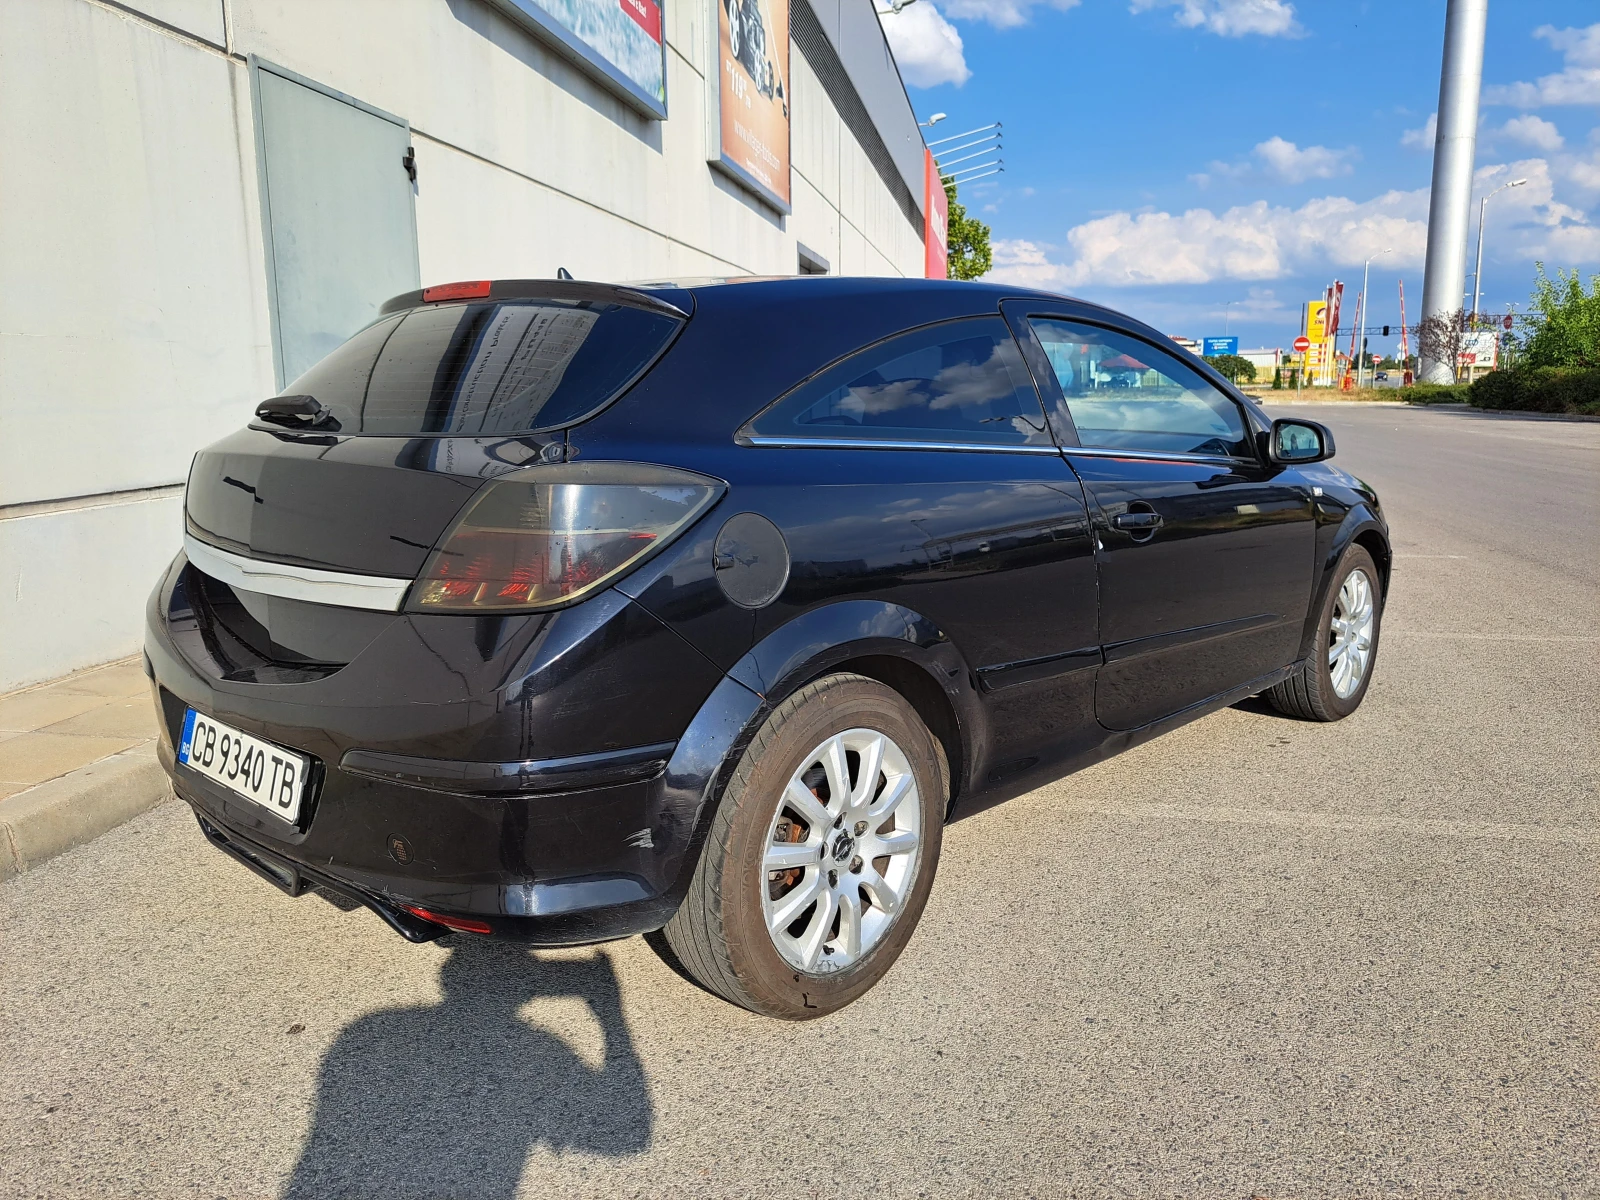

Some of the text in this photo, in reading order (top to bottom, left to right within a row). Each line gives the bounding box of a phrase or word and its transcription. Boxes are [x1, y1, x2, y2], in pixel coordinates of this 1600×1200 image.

[181, 742, 191, 756] BG
[192, 721, 296, 809] CB 9340 TB
